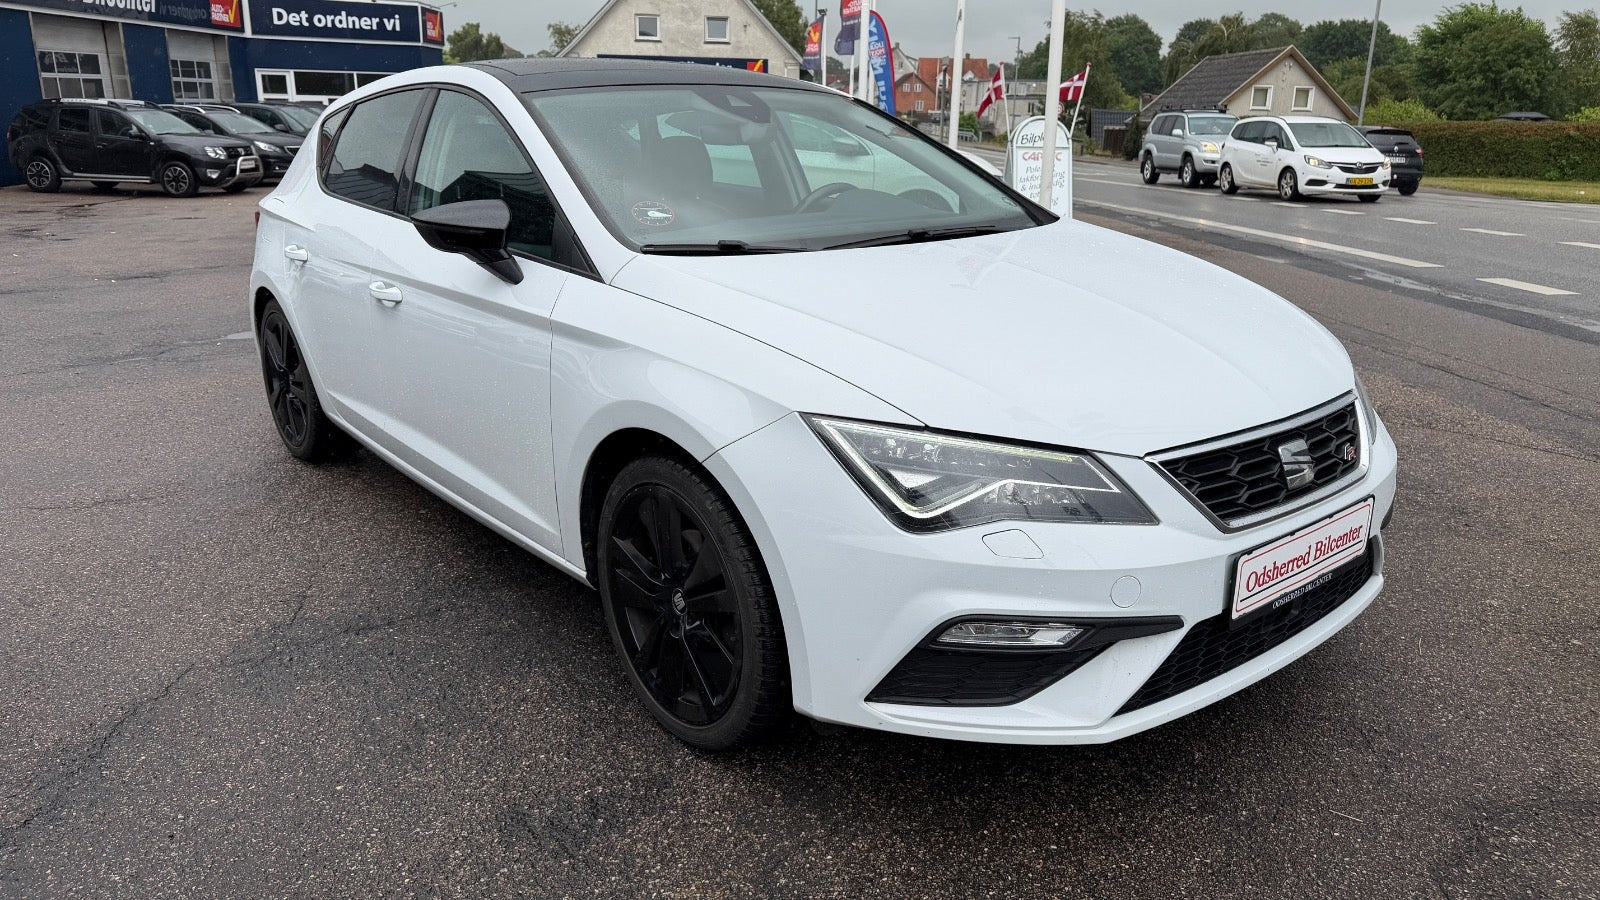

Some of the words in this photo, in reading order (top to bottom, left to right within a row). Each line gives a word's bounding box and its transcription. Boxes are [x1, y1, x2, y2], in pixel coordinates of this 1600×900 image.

[271, 7, 309, 27] Det
[313, 11, 380, 30] ordner
[383, 14, 401, 32] vi
[1246, 545, 1312, 593] Odsherred
[1313, 524, 1363, 562] Bilcenter
[1272, 588, 1305, 609] ODSHERRED
[1304, 572, 1333, 593] BILCENTER
